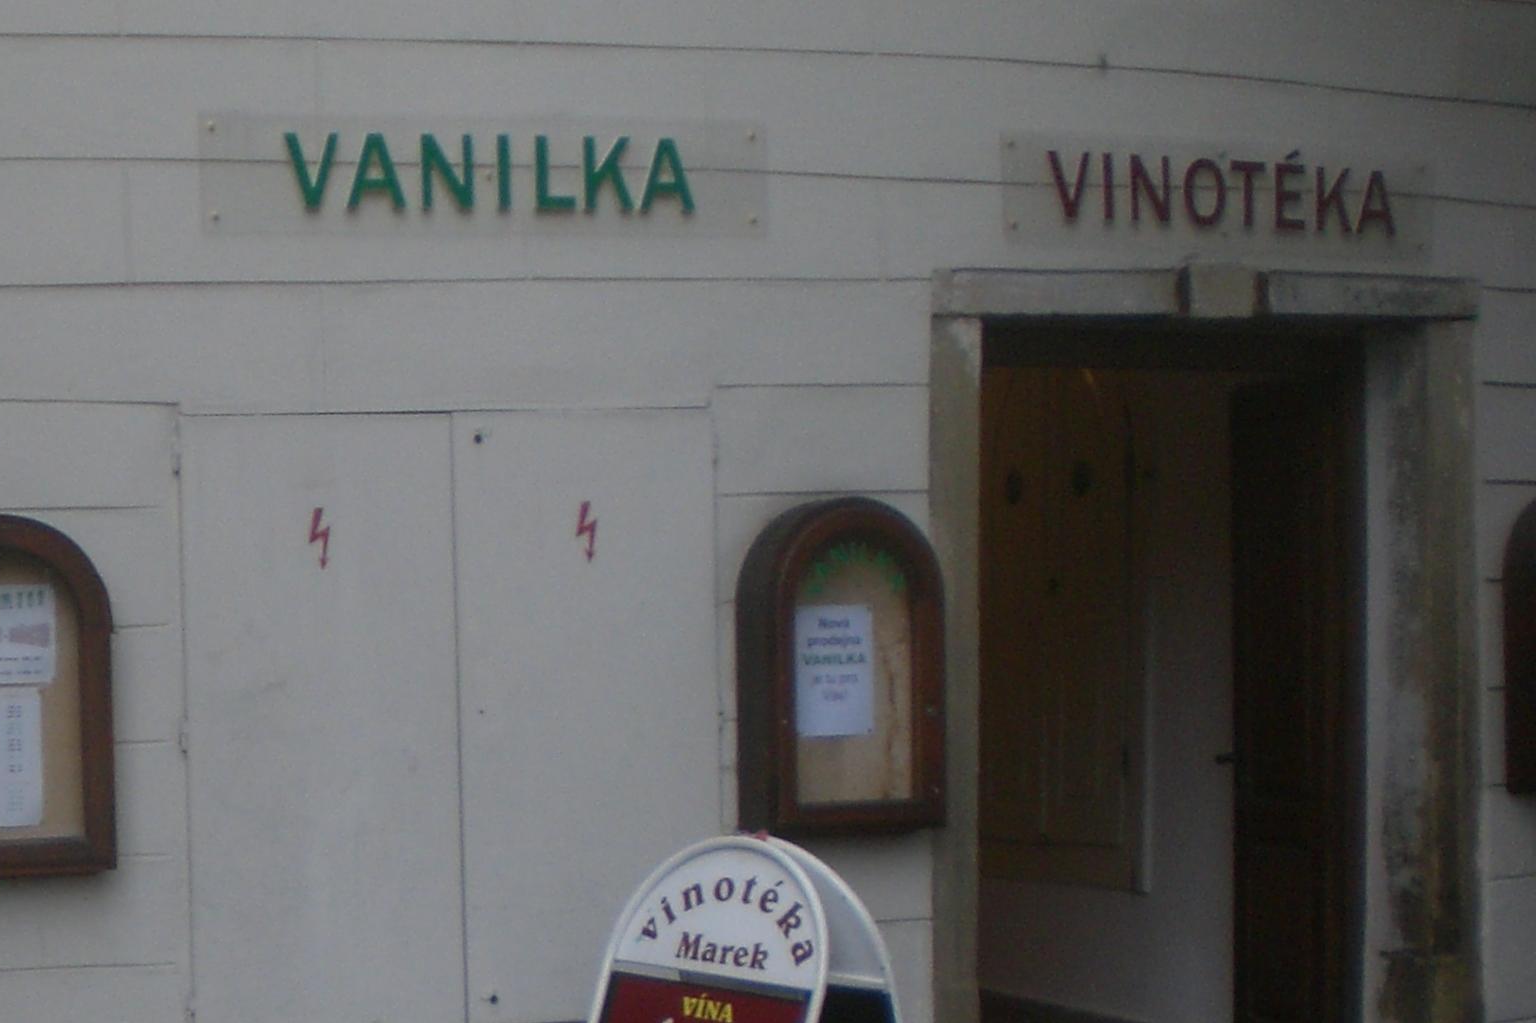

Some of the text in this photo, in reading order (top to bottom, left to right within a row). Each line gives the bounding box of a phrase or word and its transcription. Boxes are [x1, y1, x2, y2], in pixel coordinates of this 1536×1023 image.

[284, 132, 695, 213] VANILKA
[1048, 150, 1397, 236] VINOTÉKA
[641, 876, 813, 966] vinotéka
[676, 931, 768, 970] Marek
[683, 993, 734, 1023] VÍNA
